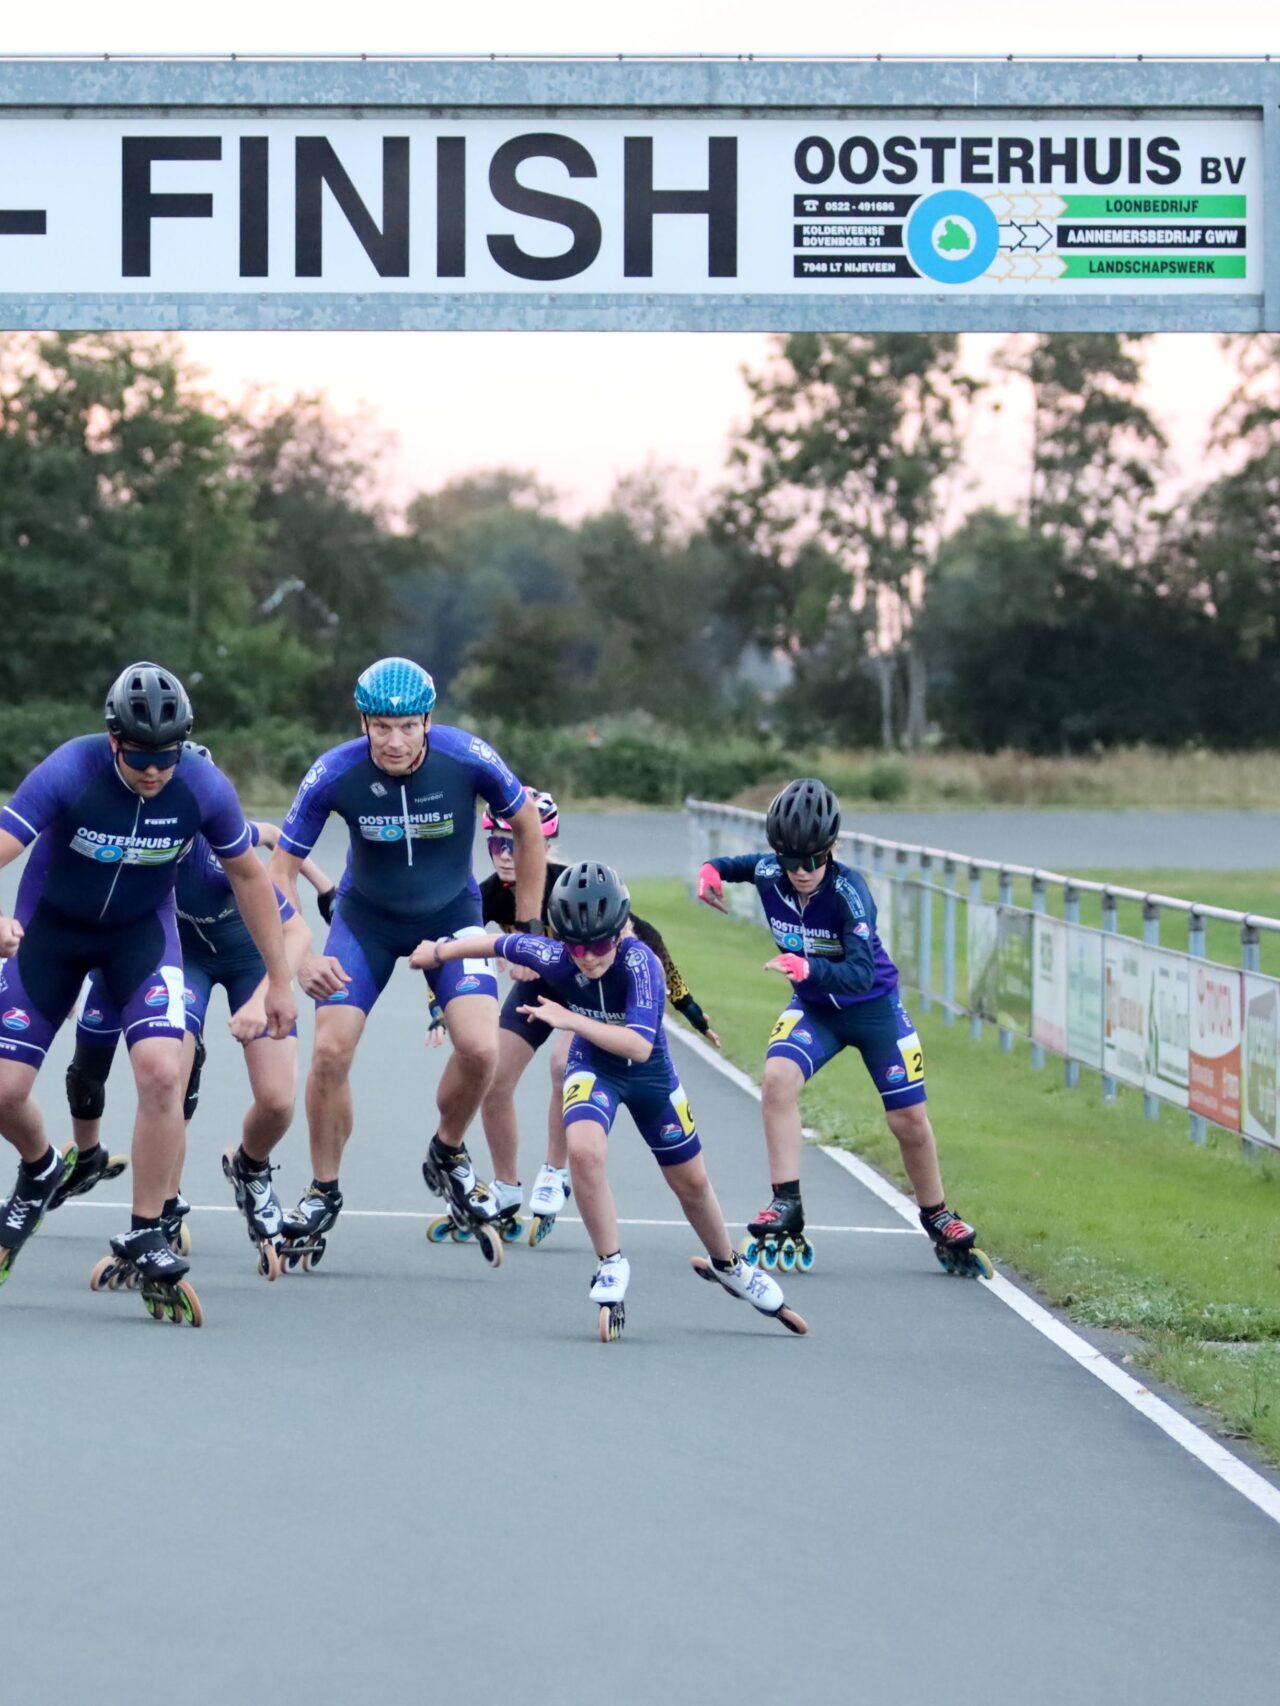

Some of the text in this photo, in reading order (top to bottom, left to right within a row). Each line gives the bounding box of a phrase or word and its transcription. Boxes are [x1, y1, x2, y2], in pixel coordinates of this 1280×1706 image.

[794, 135, 1246, 185] OOSTERHUIS BV
[122, 132, 738, 281] FINISH
[825, 202, 851, 212] 0522
[1105, 199, 1200, 214] LOONBEDRIJF
[802, 226, 885, 236] KOLDERVEENSE
[1067, 229, 1239, 244] AANNEMERSBEDRIJF GWW
[802, 236, 881, 246] BOVENBOER 31
[802, 262, 896, 273] 7948 LT NIJEVEEN
[1088, 260, 1216, 275] LANDSCHAPSWERK
[358, 812, 441, 826] OOSTERHUIS
[76, 827, 172, 849] OOSTERHUIS
[564, 1083, 581, 1103] 2
